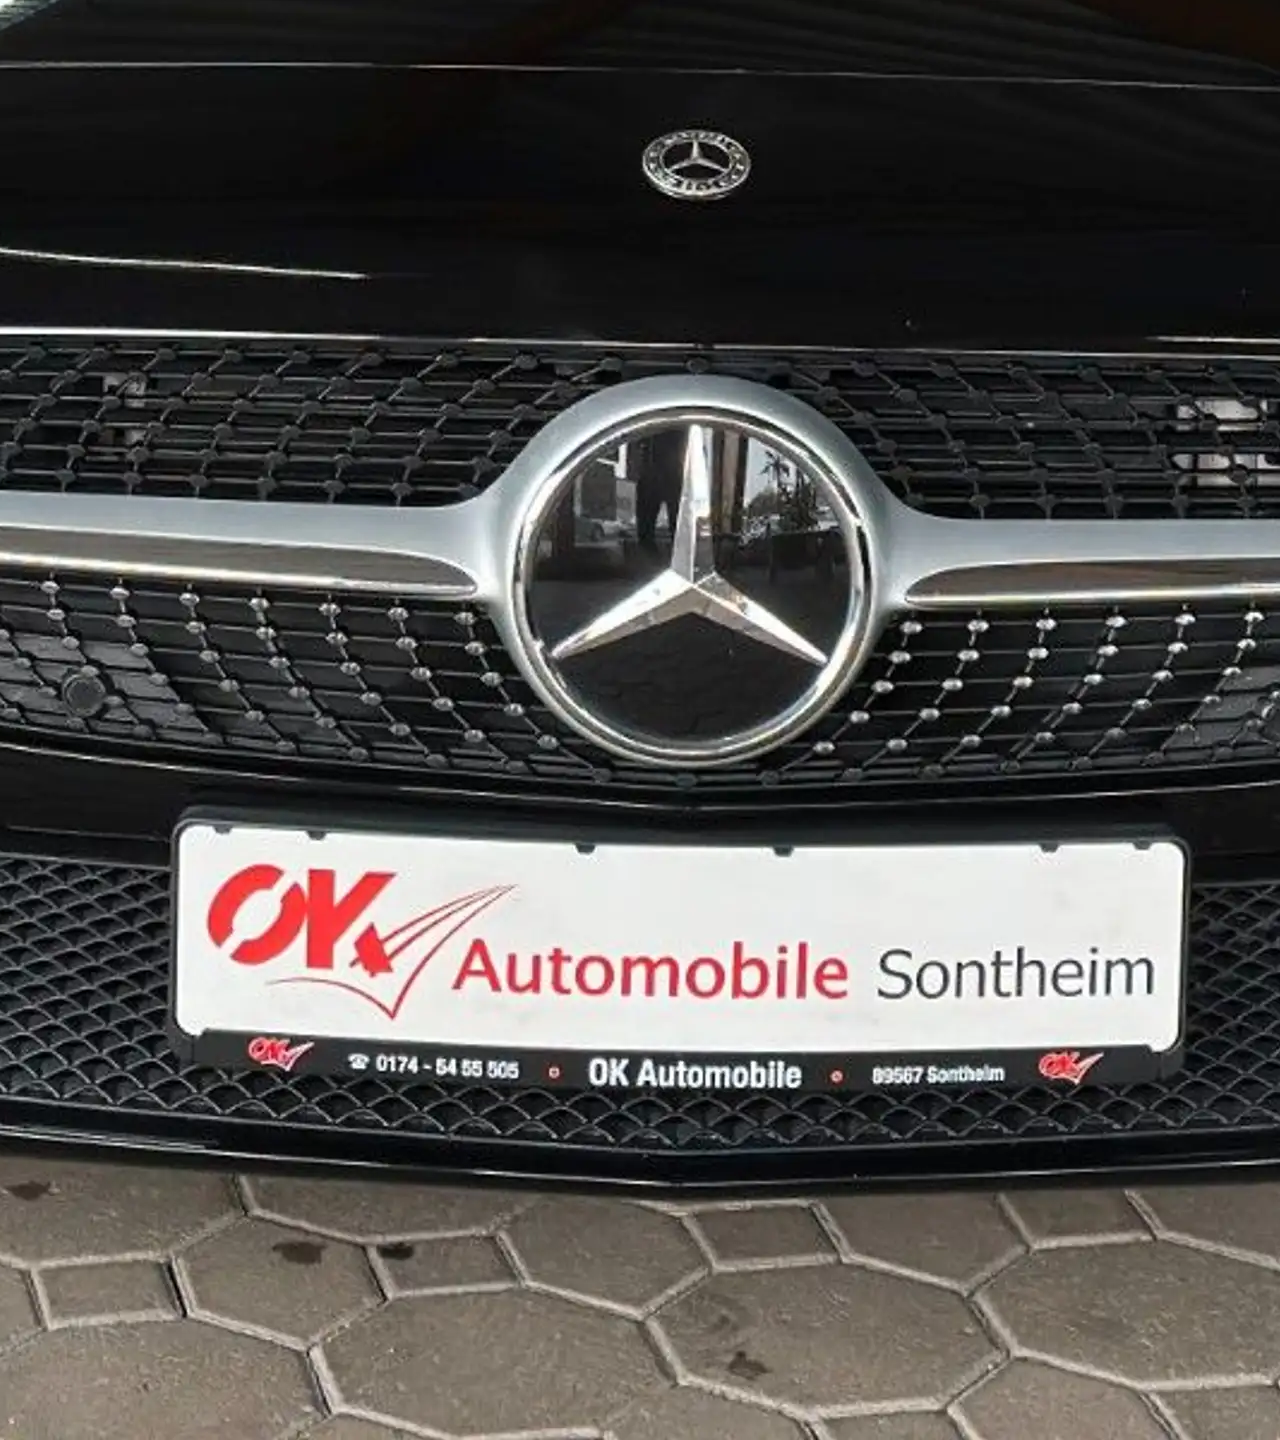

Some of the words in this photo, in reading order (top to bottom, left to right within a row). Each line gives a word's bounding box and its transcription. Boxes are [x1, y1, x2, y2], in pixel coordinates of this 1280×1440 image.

[207, 863, 395, 978] OK
[452, 938, 848, 1000] Automobile
[877, 946, 1155, 1000] Sontheim
[375, 1053, 419, 1074] 0174
[488, 1060, 519, 1080] 505
[588, 1058, 629, 1087] OK
[636, 1058, 803, 1089] Automobile
[926, 1064, 1005, 1085] Sontheim
